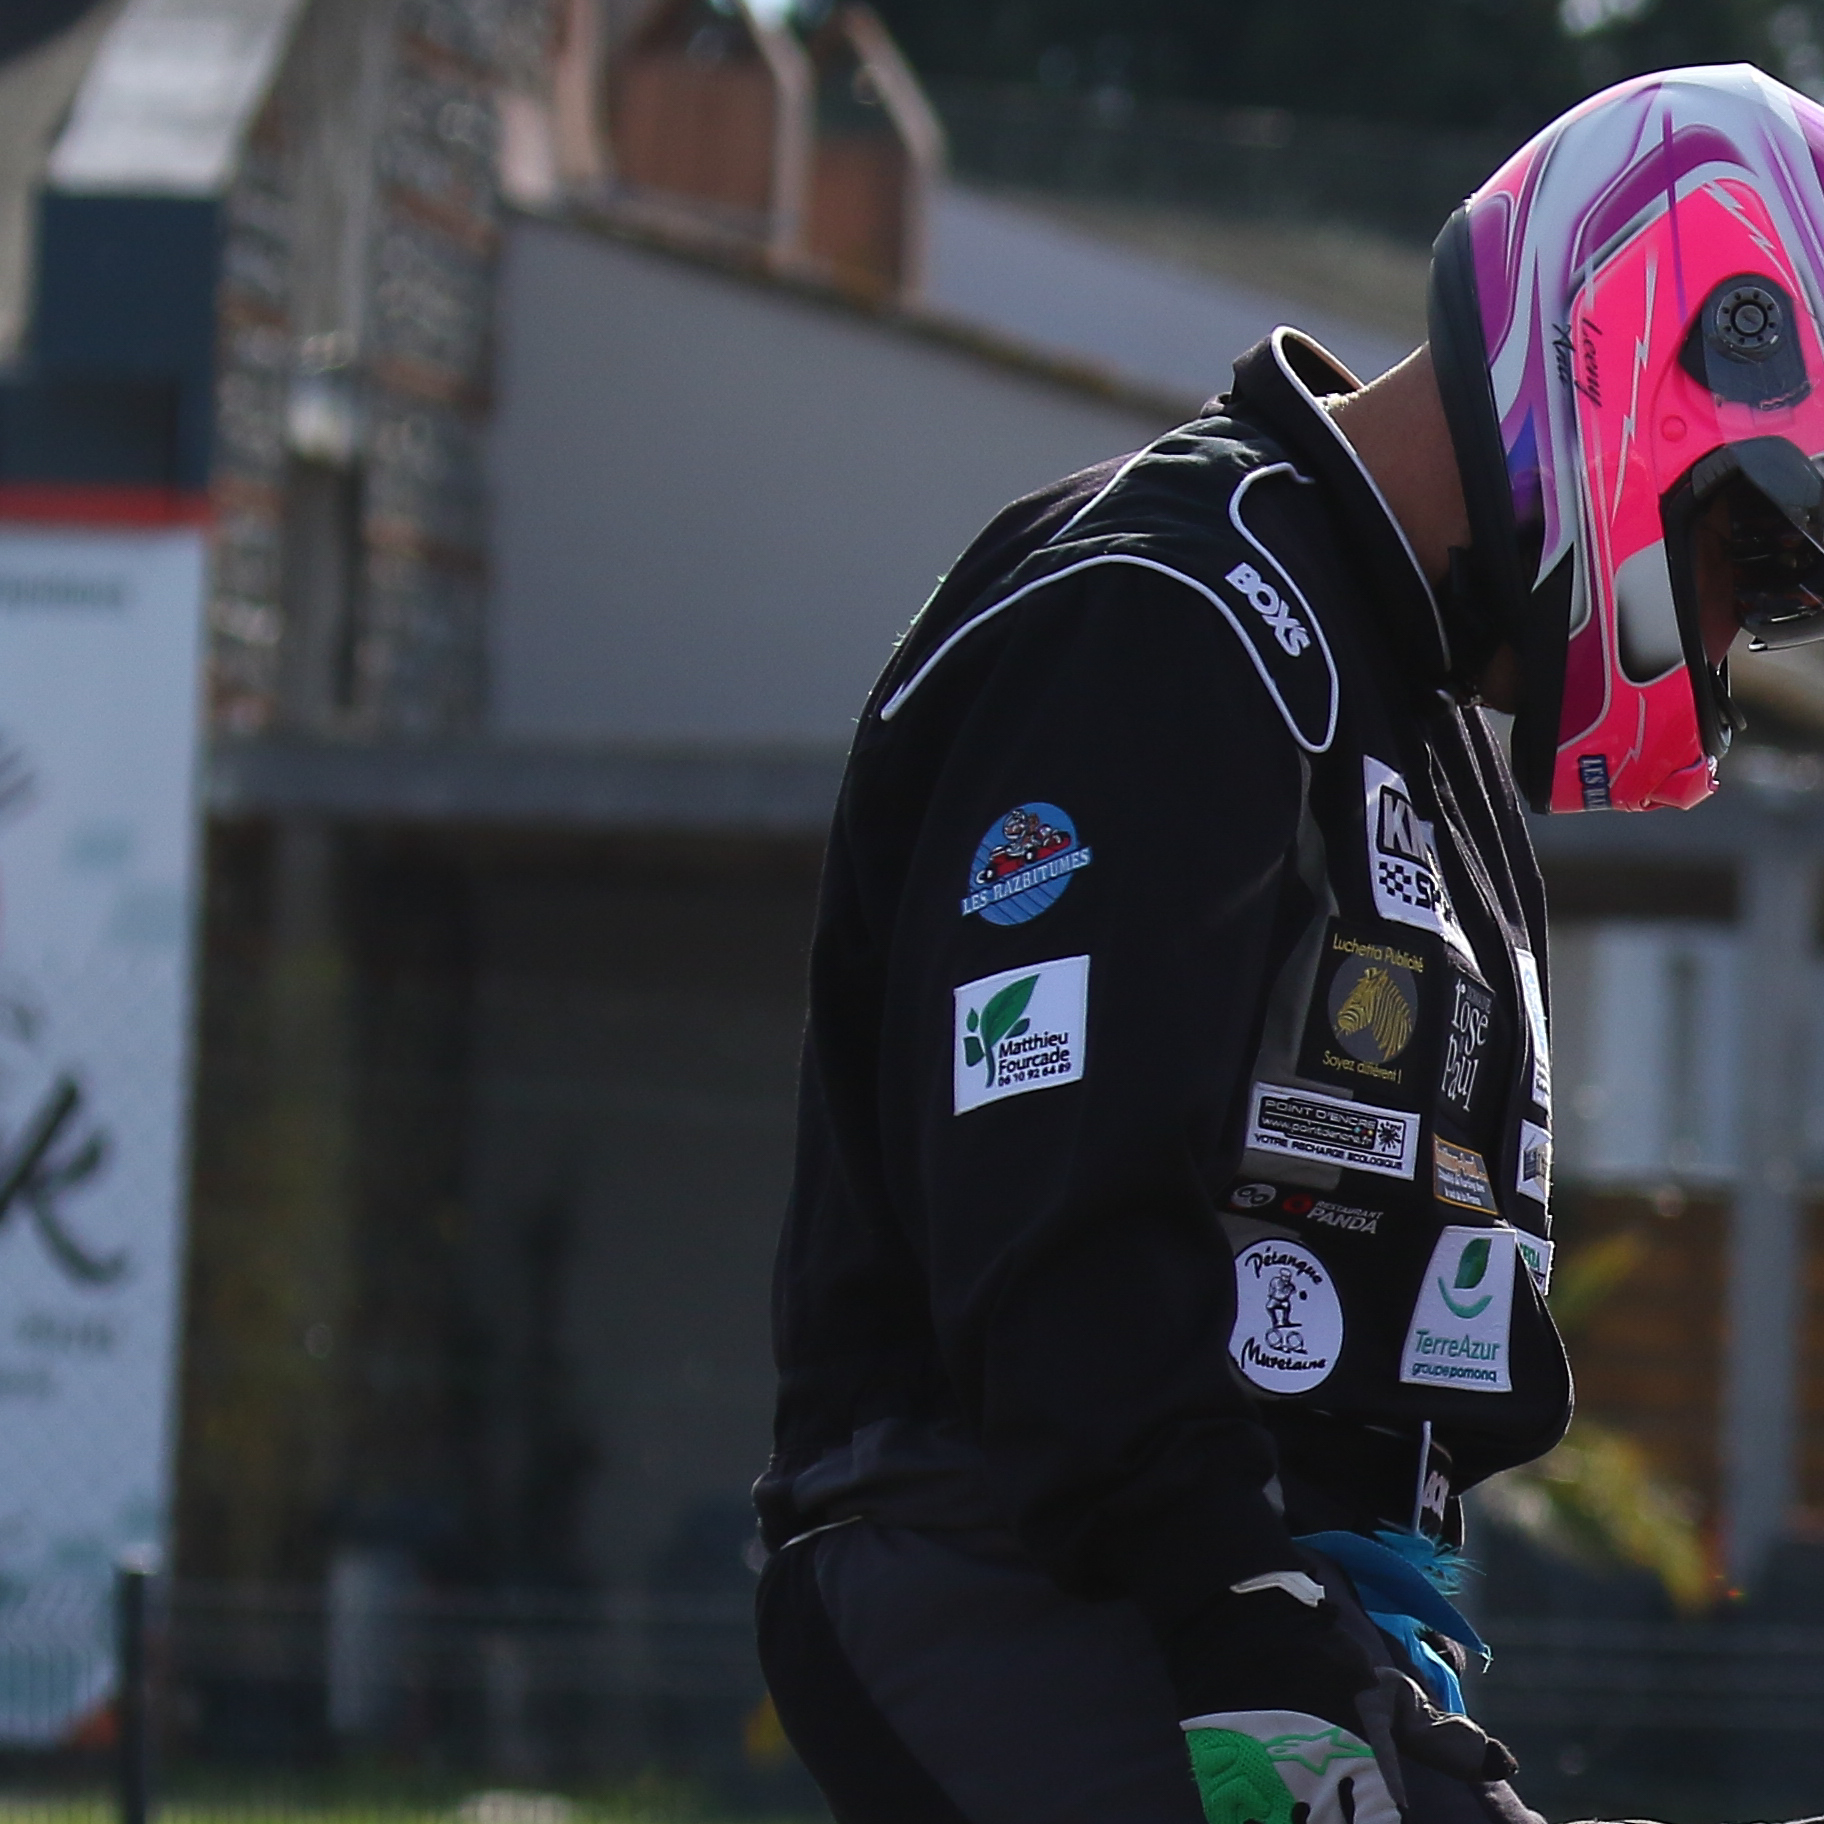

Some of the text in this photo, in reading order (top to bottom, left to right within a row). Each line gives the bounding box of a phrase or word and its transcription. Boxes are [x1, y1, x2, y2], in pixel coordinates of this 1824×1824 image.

[963, 847, 1092, 915] LES RAZBITUMES
[999, 1030, 1069, 1058] Matthieu
[998, 1048, 1071, 1075] Fourcade
[1322, 1050, 1355, 1070] Soyez
[1441, 1033, 1479, 1112] Paul
[1264, 1099, 1377, 1128] POINT D'ENCRE
[1254, 1134, 1288, 1148] VOTRE
[1307, 1208, 1378, 1234] PANDA
[1245, 1246, 1323, 1286] Pétanque
[1415, 1330, 1500, 1361] TerreAzur
